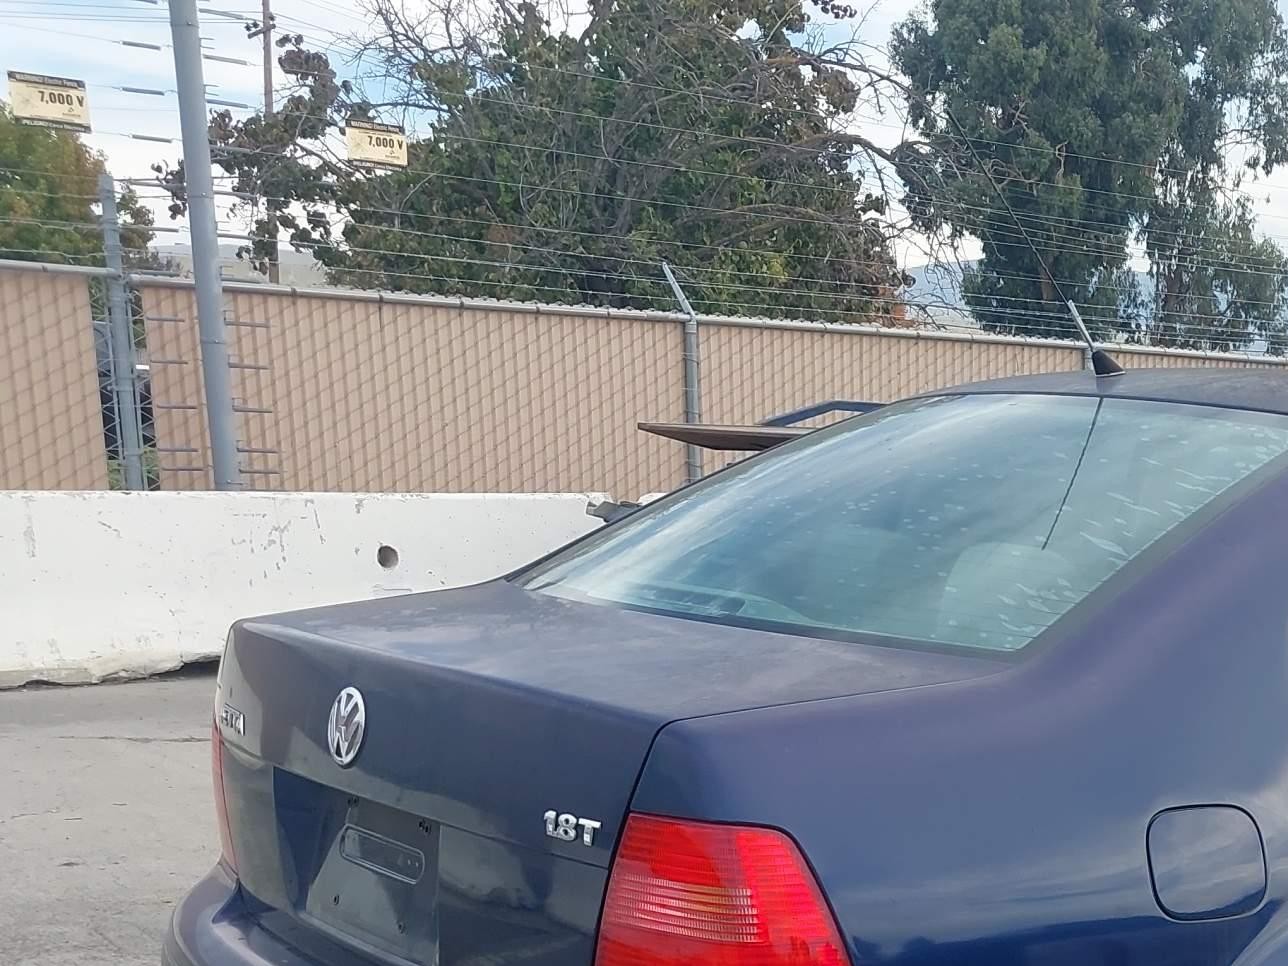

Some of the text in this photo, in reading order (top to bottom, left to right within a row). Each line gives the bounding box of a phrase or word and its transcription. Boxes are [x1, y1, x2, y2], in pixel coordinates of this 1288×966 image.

[37, 90, 84, 107] 7,000 V
[367, 135, 403, 150] 7,000 V
